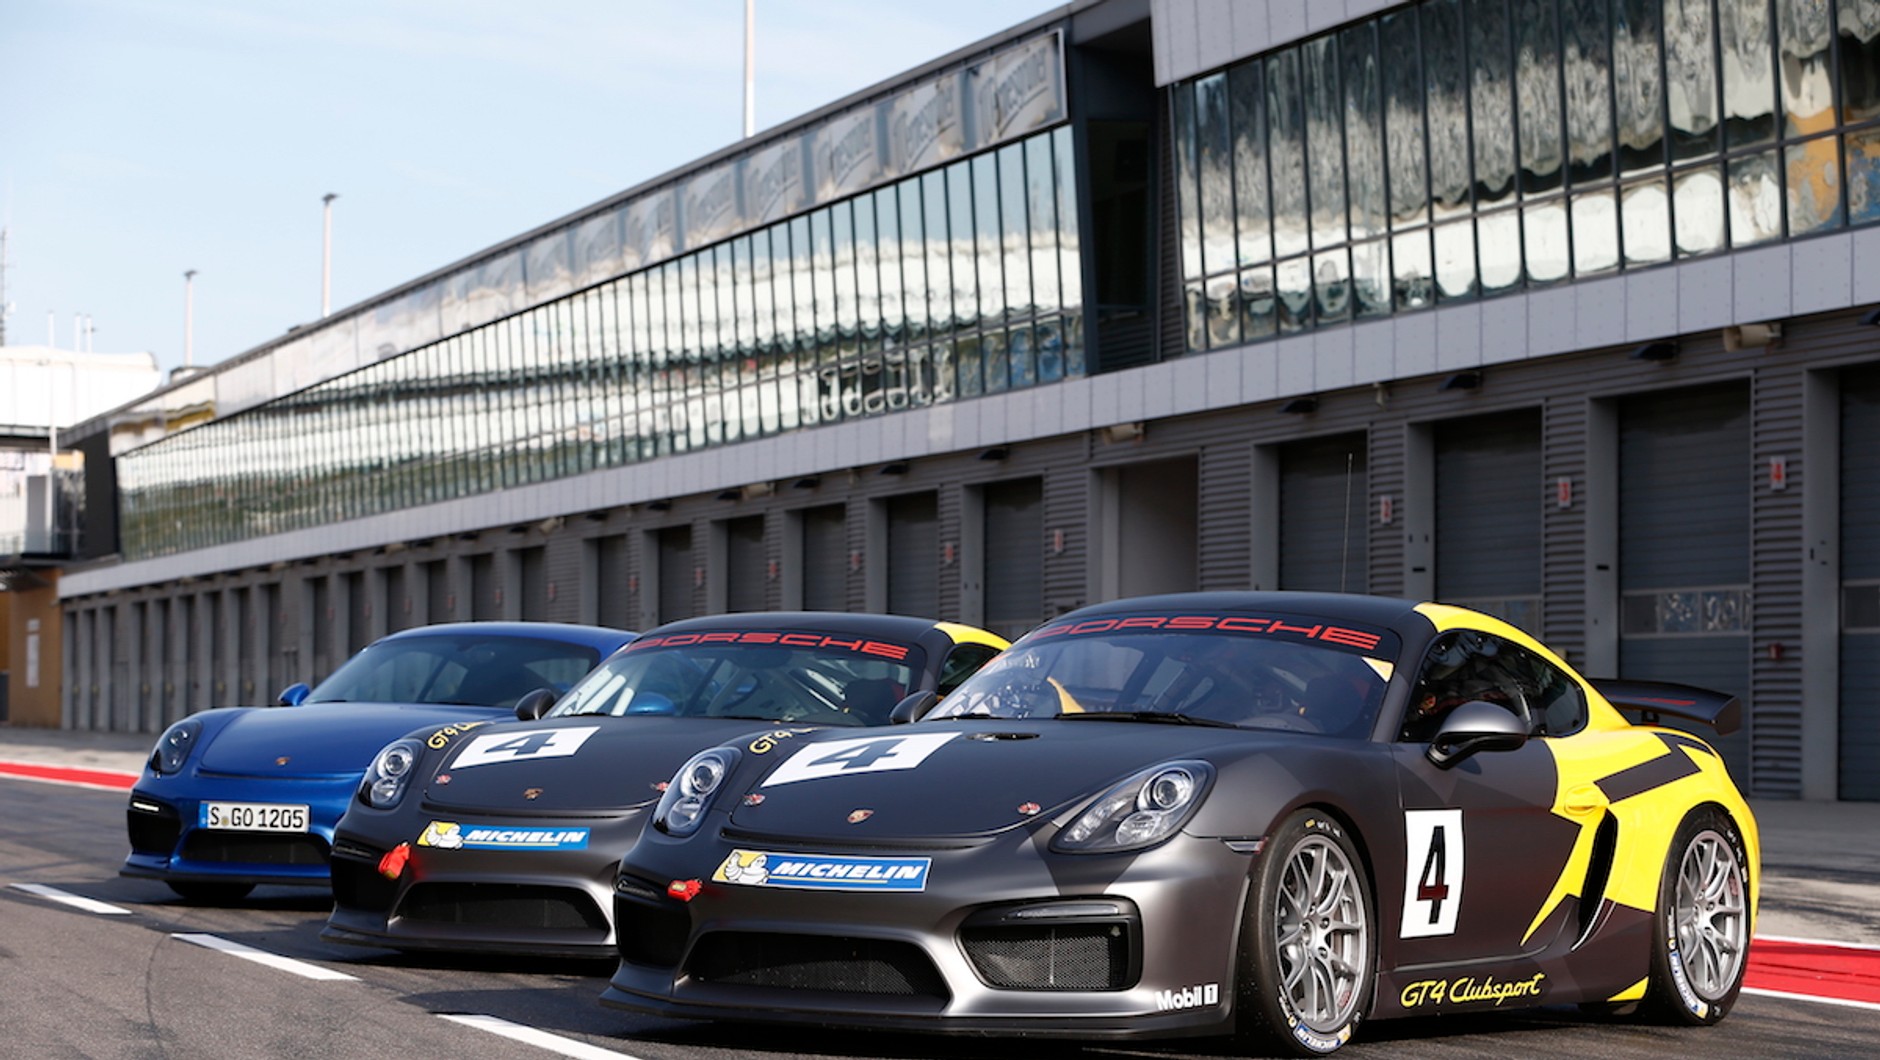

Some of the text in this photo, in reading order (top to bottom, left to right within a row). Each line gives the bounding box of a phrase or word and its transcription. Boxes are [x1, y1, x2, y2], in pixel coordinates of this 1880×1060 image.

[624, 632, 909, 660] PORSCHE
[1031, 616, 1381, 651] PORSCHE
[483, 731, 559, 757] 4
[807, 737, 908, 770] 4
[210, 806, 304, 828] S GO 1205
[465, 829, 586, 843] MICHELIN
[771, 861, 924, 880] MICHELIN
[1417, 825, 1449, 924] 4
[1155, 984, 1203, 1010] Mobil
[1401, 972, 1546, 1007] GT4 Clubsport
